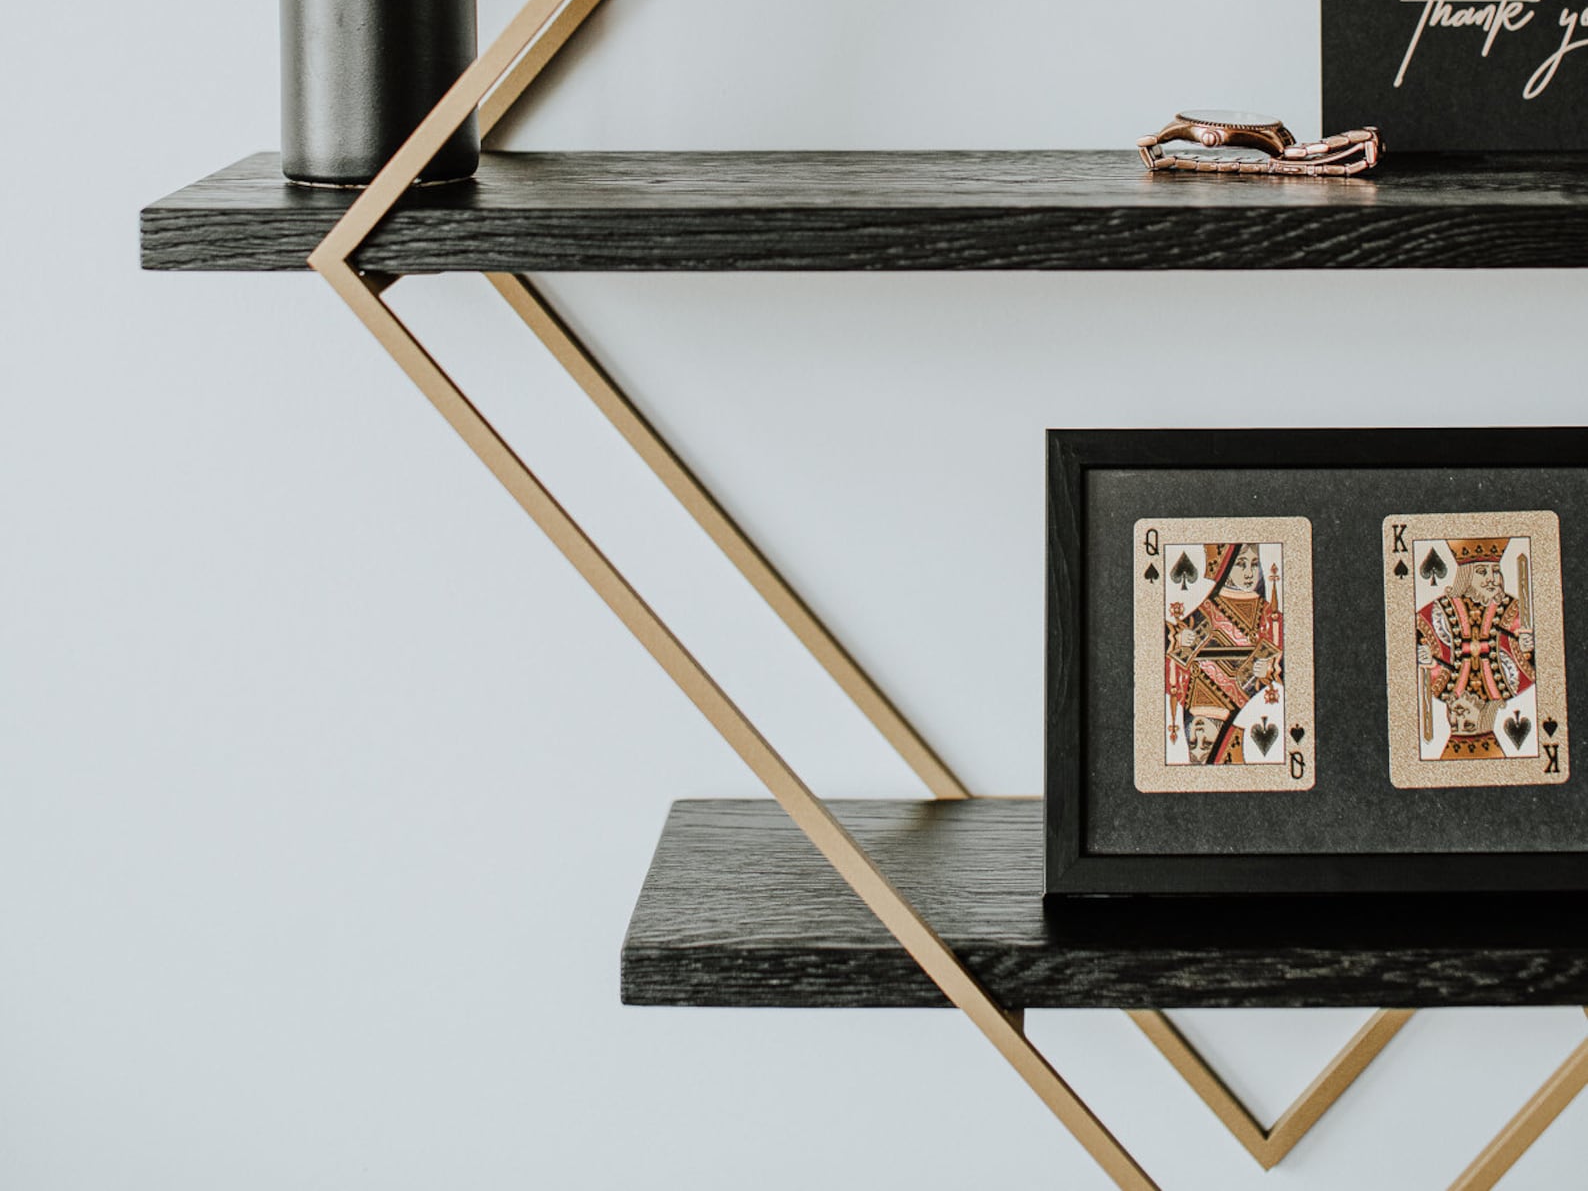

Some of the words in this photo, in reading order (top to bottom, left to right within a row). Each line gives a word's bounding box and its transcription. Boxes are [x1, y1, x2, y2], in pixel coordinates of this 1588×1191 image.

[1145, 528, 1160, 555] Q
[1392, 524, 1408, 553] K
[1290, 752, 1306, 779] Q
[1544, 744, 1560, 773] K
